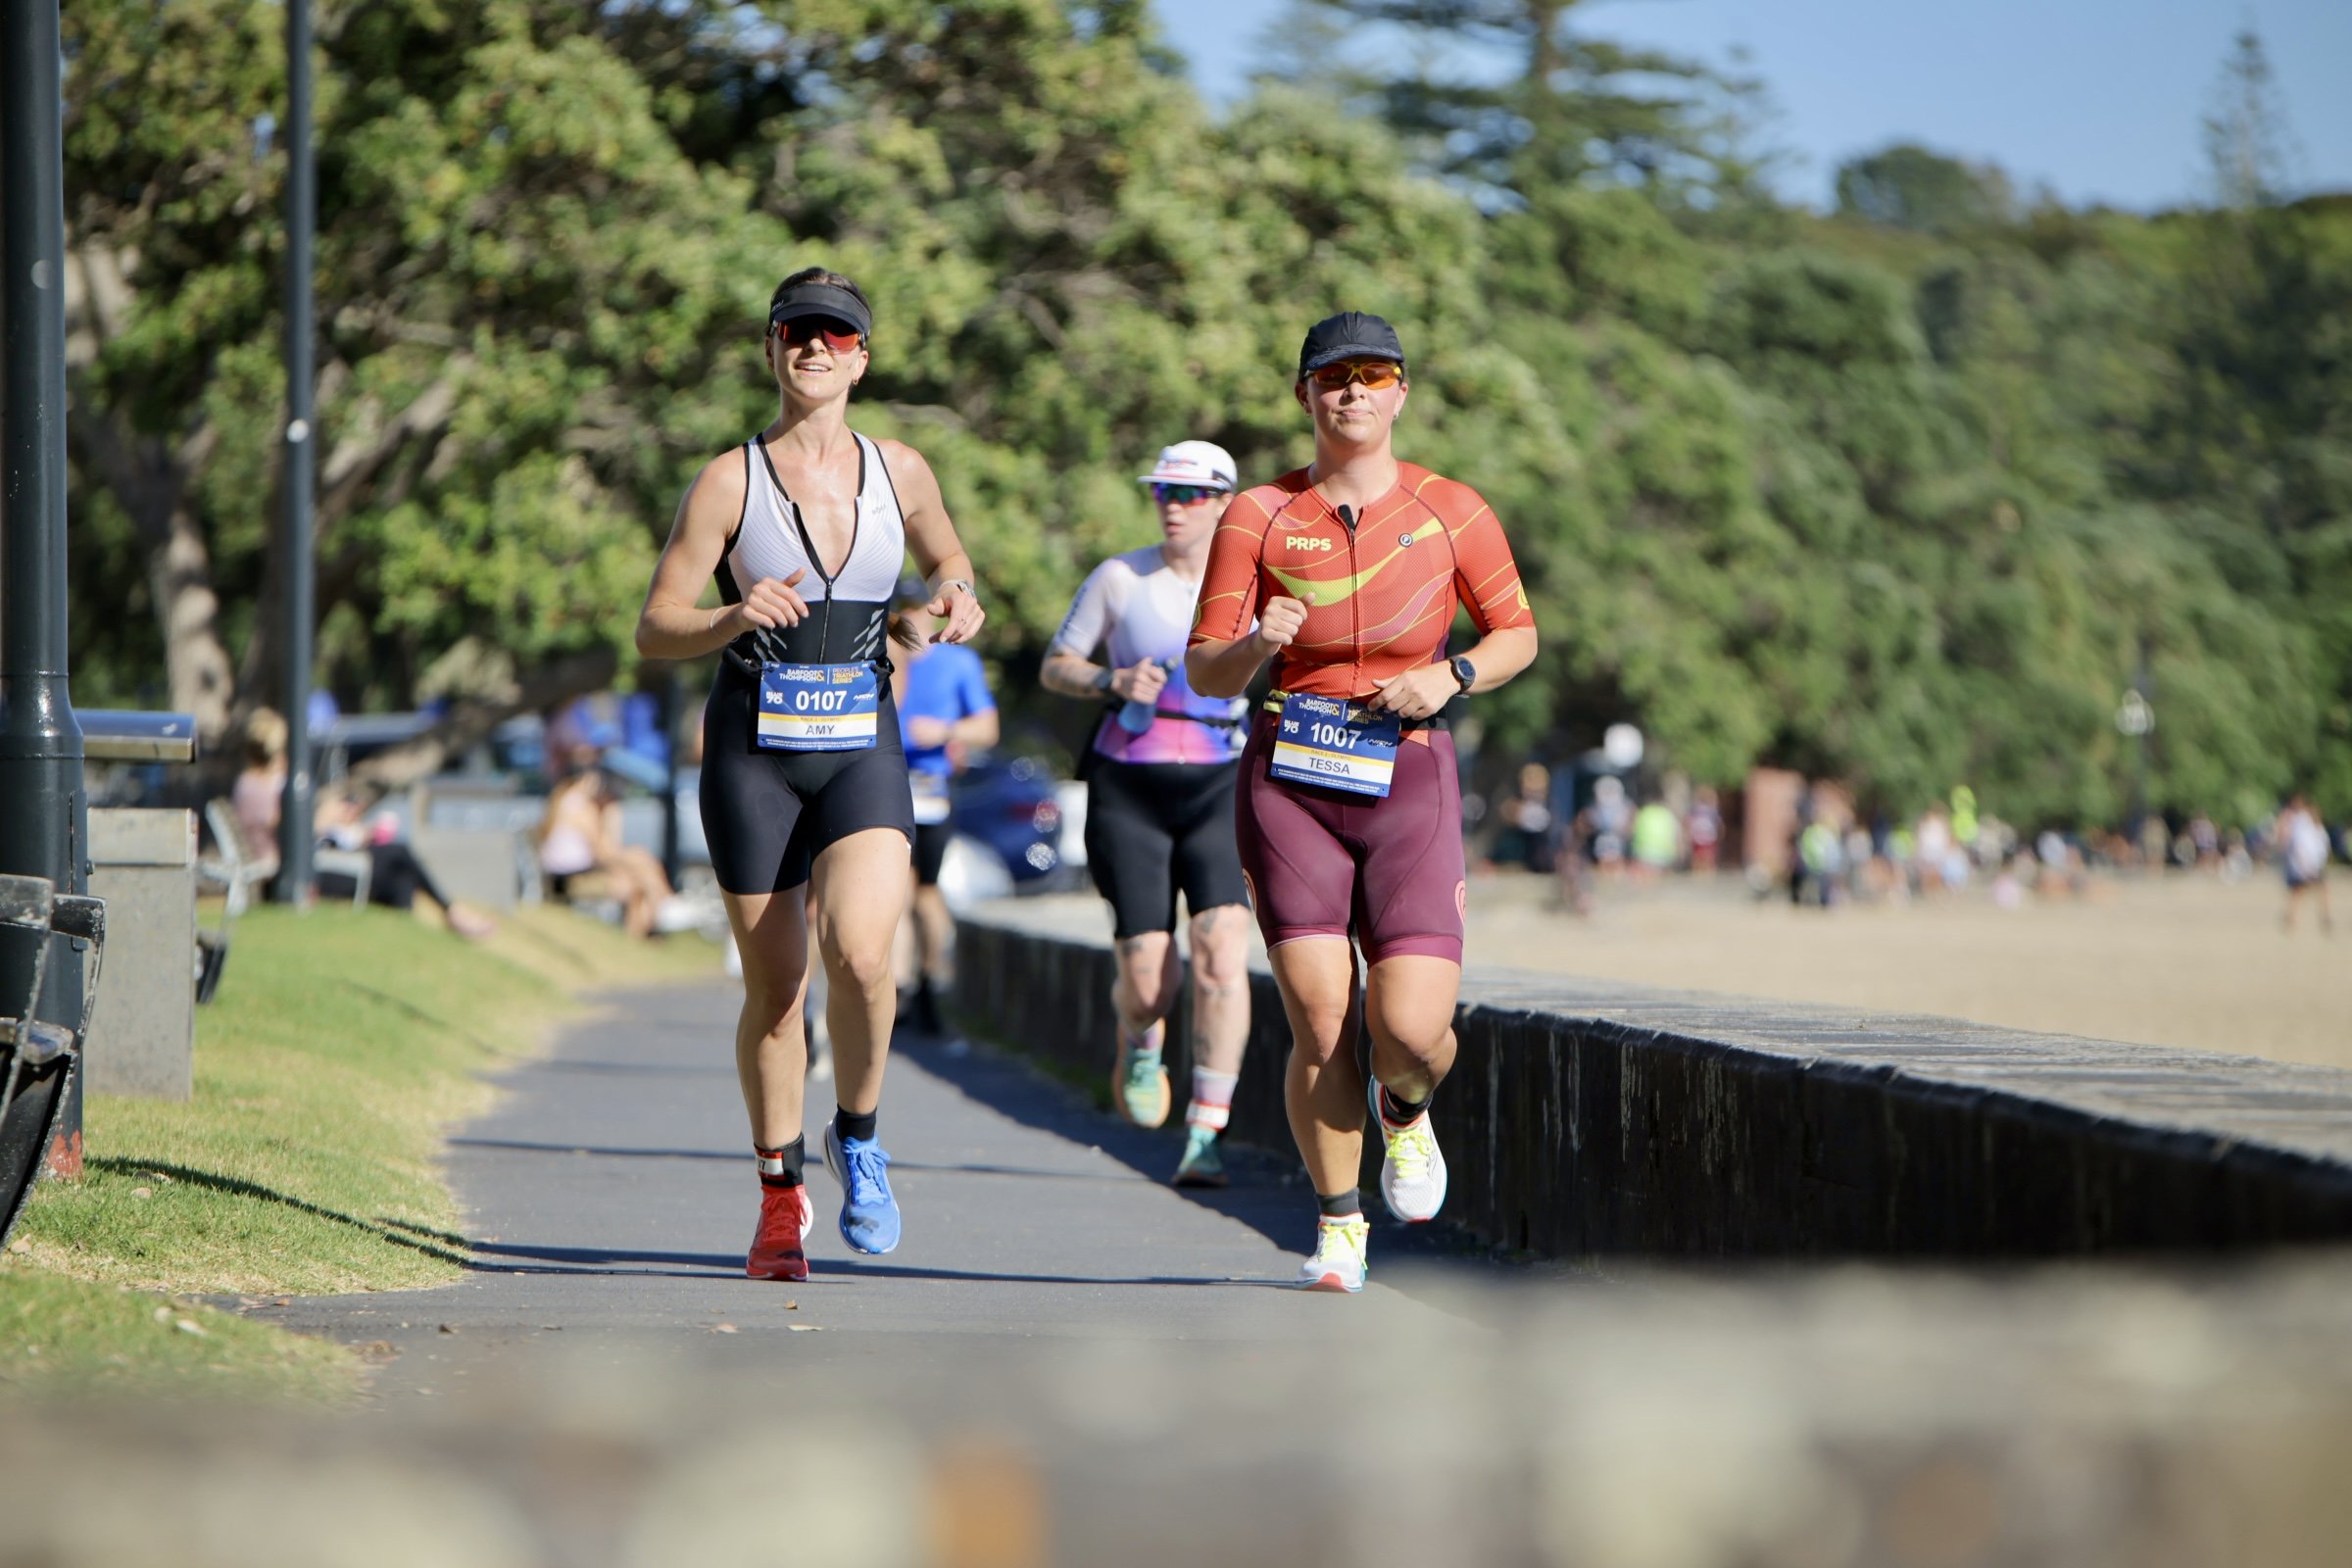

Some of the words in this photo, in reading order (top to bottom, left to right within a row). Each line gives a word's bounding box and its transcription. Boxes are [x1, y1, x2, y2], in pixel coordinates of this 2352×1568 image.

[1287, 536, 1331, 551] PRPS
[766, 696, 783, 705] 70
[796, 690, 847, 710] 0107
[1306, 698, 1333, 708] BARFOOT
[1298, 702, 1332, 714] THOMPSON
[806, 725, 835, 735] AMY
[1284, 724, 1298, 734] 70
[1310, 722, 1361, 749] 1007
[1309, 757, 1349, 774] TESSA
